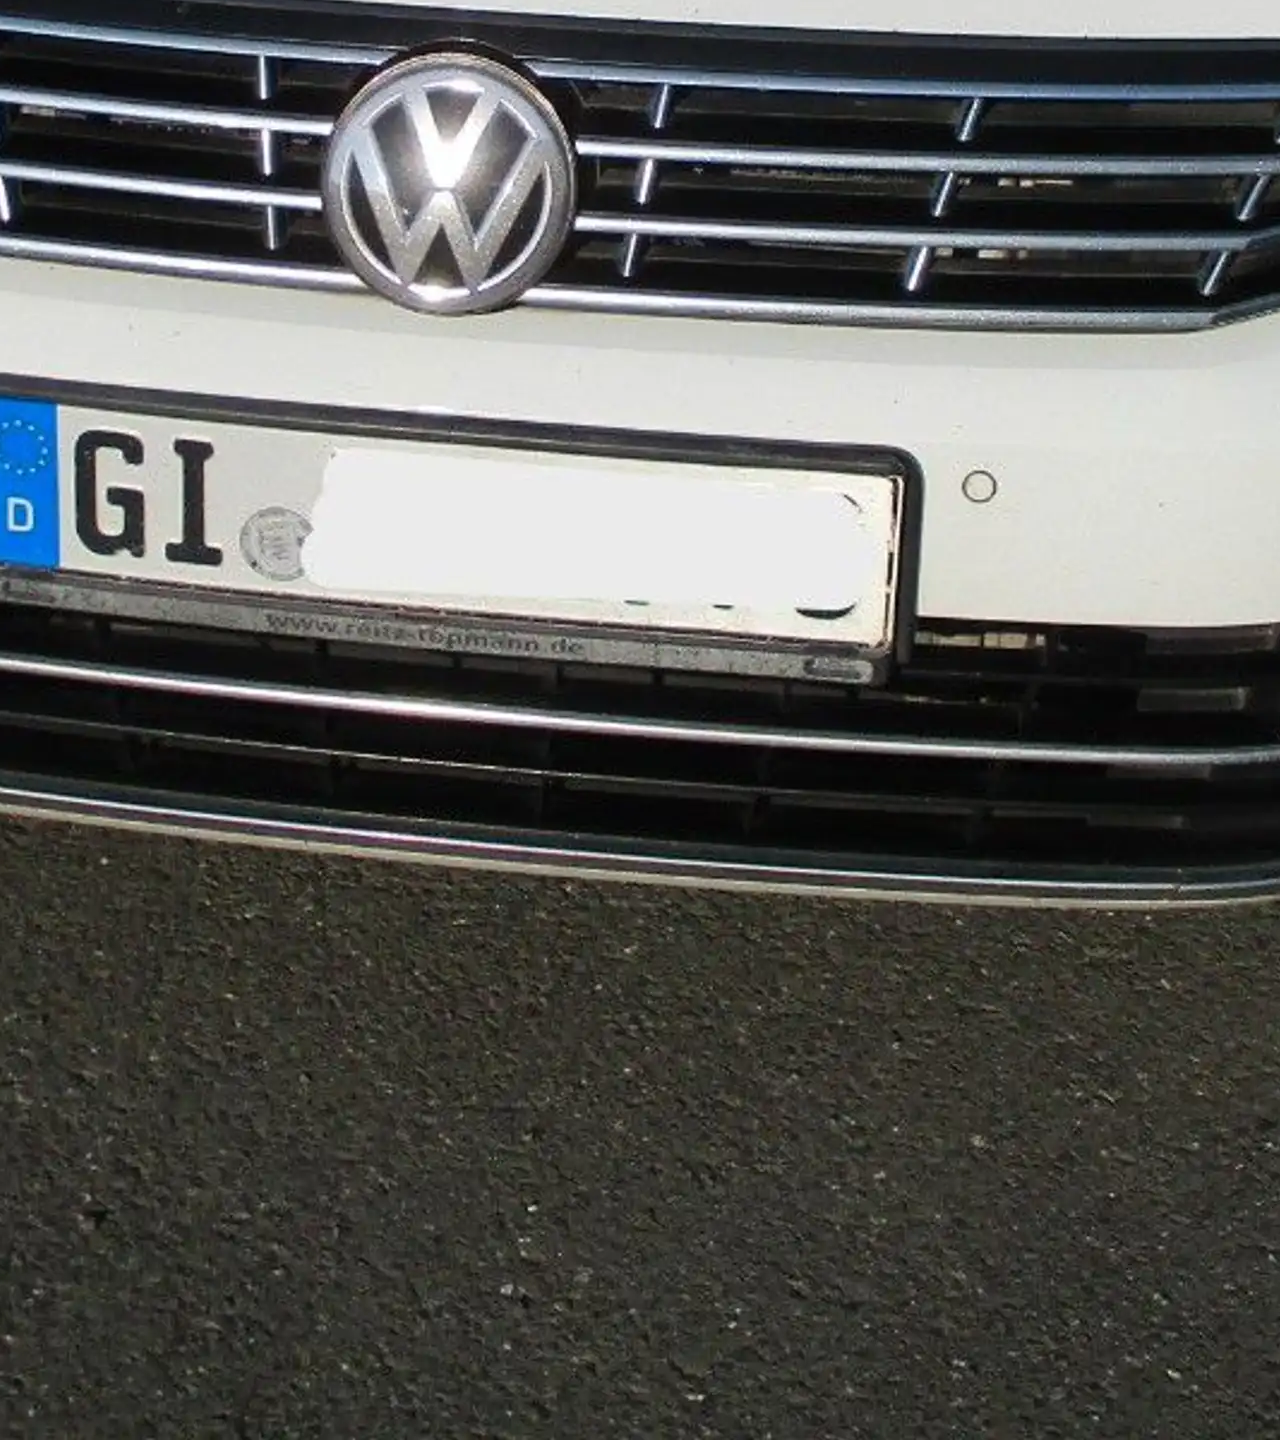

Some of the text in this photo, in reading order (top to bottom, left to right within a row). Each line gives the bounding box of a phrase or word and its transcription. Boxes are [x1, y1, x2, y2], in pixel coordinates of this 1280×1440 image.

[340, 72, 558, 298] VW
[6, 496, 34, 532] D
[73, 428, 224, 567] GI
